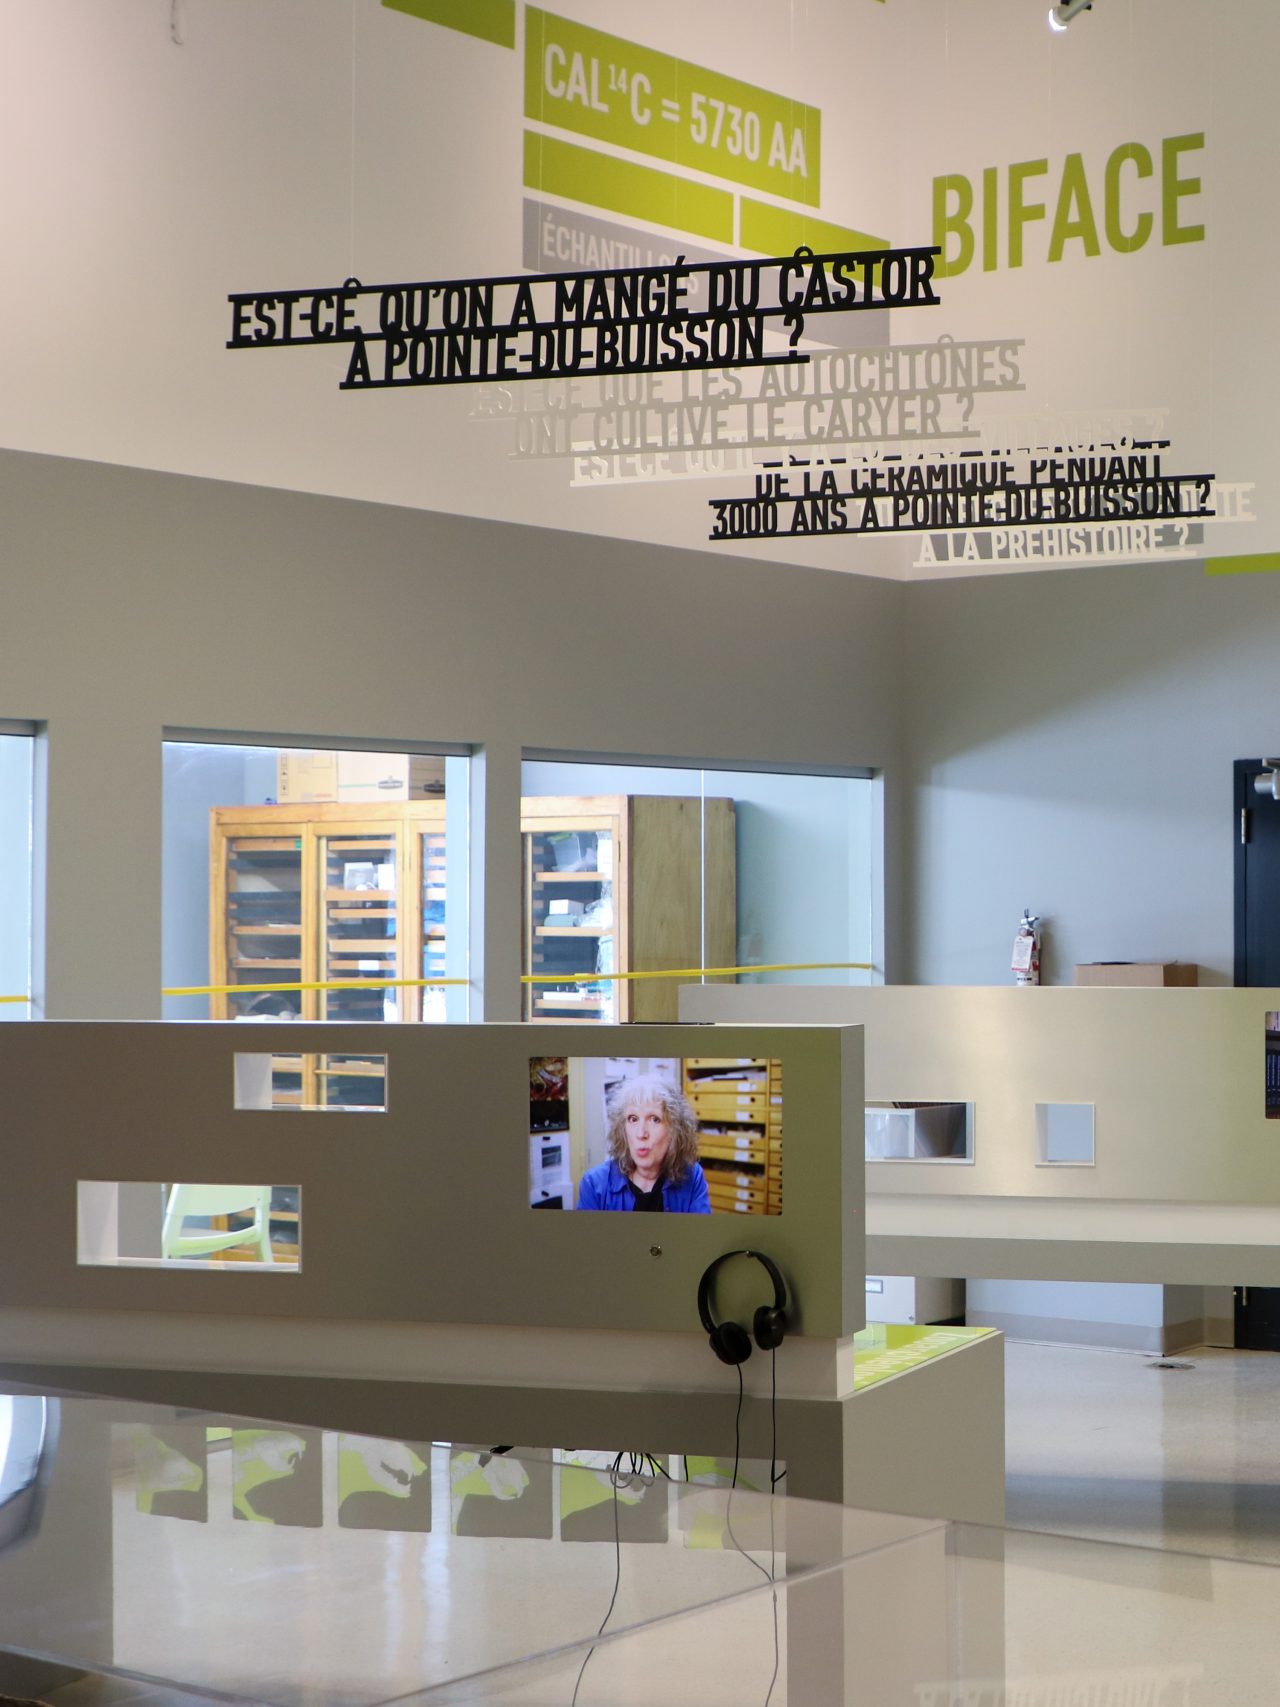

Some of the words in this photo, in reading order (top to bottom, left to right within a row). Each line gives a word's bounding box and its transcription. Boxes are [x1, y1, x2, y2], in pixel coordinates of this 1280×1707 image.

[661, 98, 681, 123] =
[690, 91, 760, 162] 5730
[768, 121, 808, 178] AA
[932, 131, 1205, 280] BIFACE
[541, 212, 700, 296] ÉCHANTILLOS
[231, 287, 358, 346] EST-CE
[379, 282, 494, 337] QU'ON
[511, 281, 538, 332] A
[554, 255, 690, 329] MANGÉ
[708, 264, 761, 316] DU
[778, 252, 936, 308] CASTOR
[384, 314, 765, 382] POINTE-DU-BUISSON
[783, 312, 805, 361] ?
[758, 346, 1021, 401] AUTOCHTONES
[747, 402, 786, 443] LE
[803, 393, 942, 442] CARYER
[956, 391, 975, 433] ?
[712, 500, 779, 536] 3000
[790, 497, 848, 532] ANS
[892, 480, 1181, 527] POINTE-DU-BUISSON
[1195, 480, 1212, 514] ?
[803, 470, 839, 497] LA
[947, 530, 982, 561] LA
[1173, 521, 1190, 551] ?
